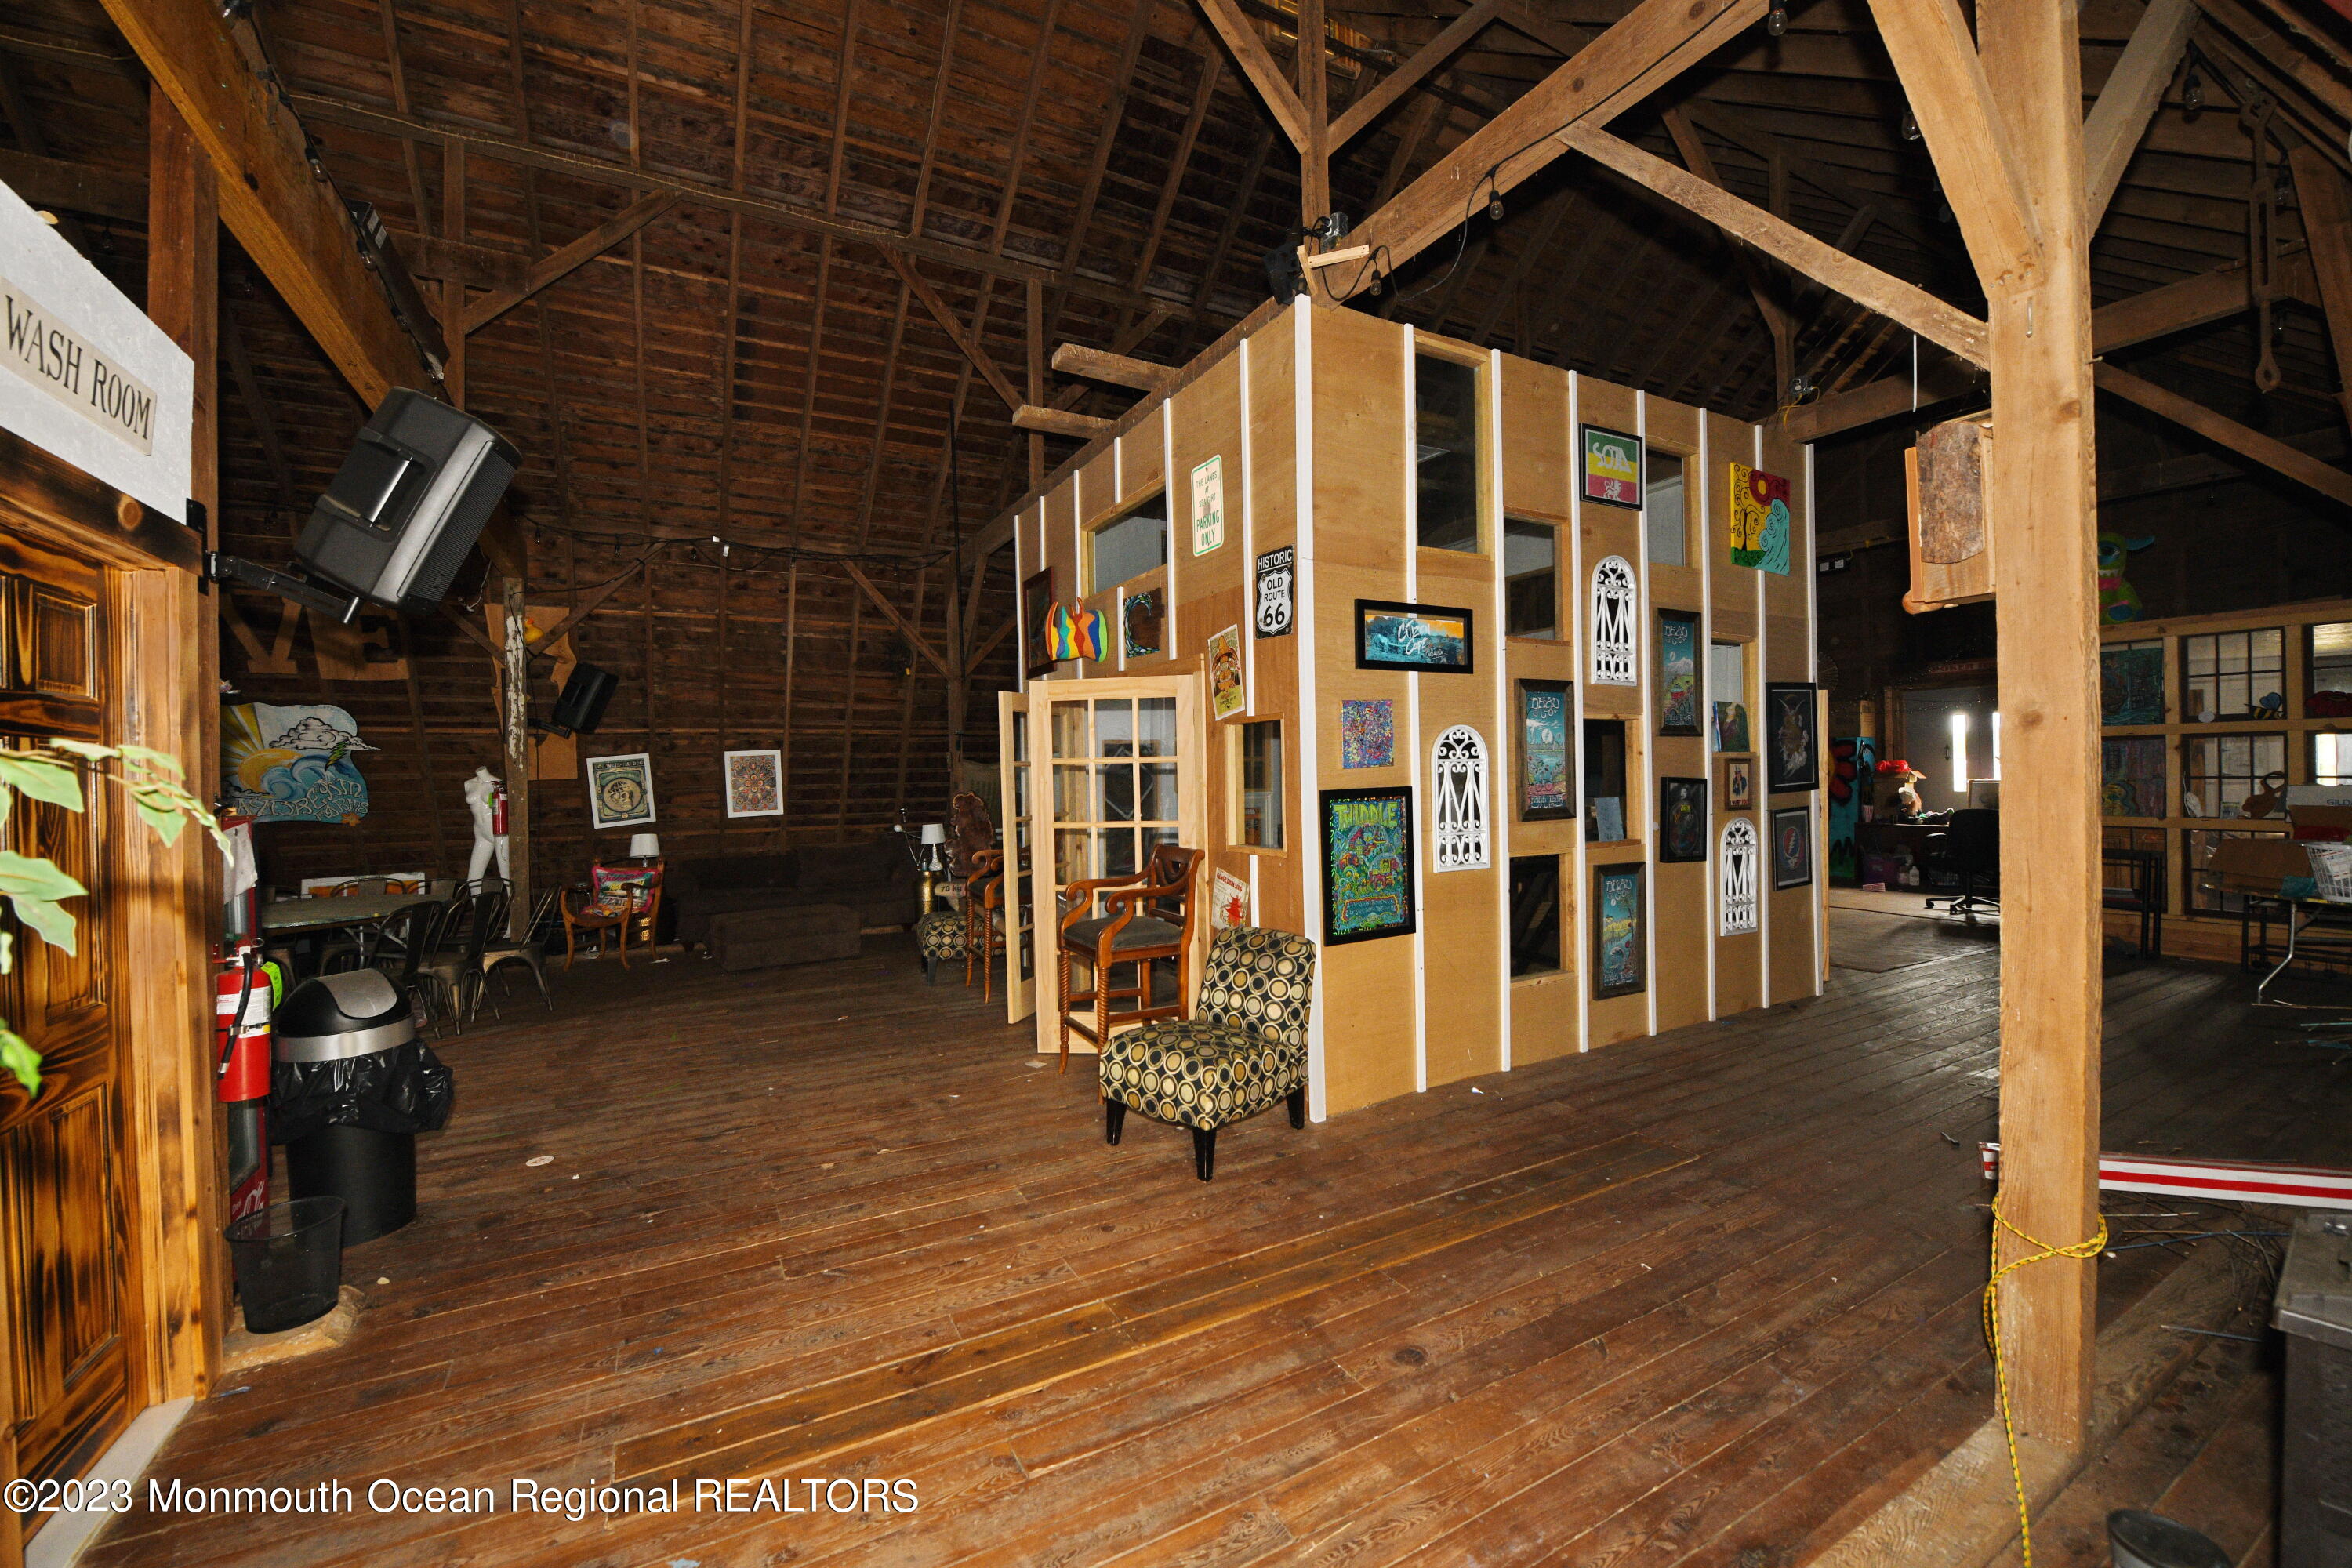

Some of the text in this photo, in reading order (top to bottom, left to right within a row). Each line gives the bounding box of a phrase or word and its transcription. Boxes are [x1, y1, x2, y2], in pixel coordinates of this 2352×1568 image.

[5, 295, 151, 440] WASH ROOM
[1205, 470, 1217, 484] LANES
[1204, 485, 1209, 494] AT
[1196, 509, 1220, 532] PARKING
[1201, 528, 1215, 546] ONLY
[1258, 549, 1292, 570] HISTORIC
[1266, 576, 1283, 590] OLD
[1264, 589, 1285, 601] ROUTE
[1263, 603, 1285, 627] 66
[2326, 798, 2352, 807] GILD
[1334, 801, 1399, 830] TWIDDLE
